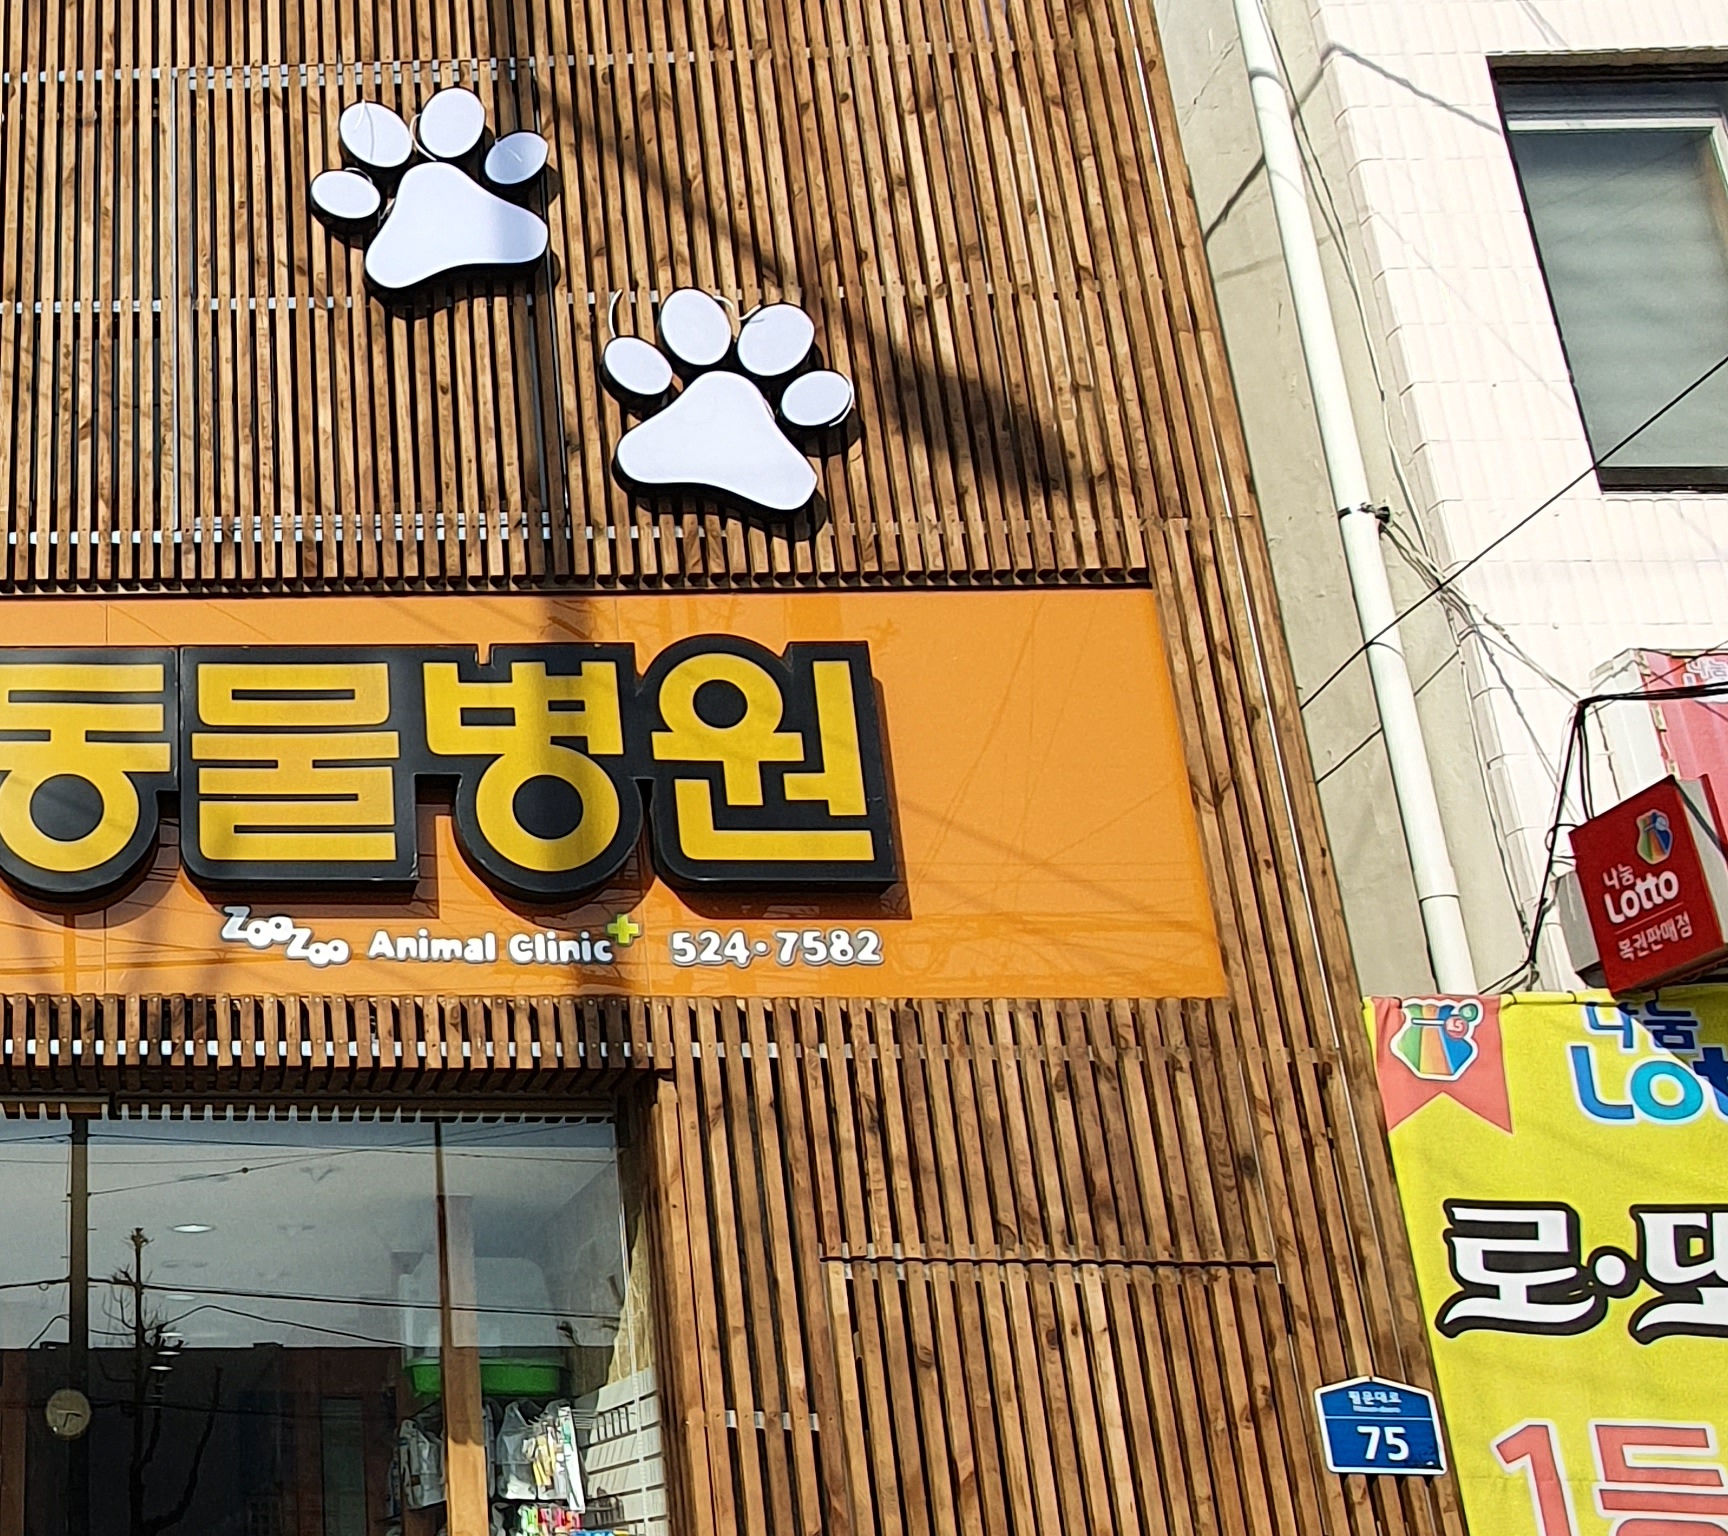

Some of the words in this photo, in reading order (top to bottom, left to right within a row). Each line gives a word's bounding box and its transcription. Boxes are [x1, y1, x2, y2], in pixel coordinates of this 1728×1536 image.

[1603, 863, 1636, 890] 나눔
[1603, 870, 1680, 924] Lotto
[221, 905, 350, 965] ZooZoo
[368, 928, 497, 963] Animal
[507, 930, 614, 964] Clinic
[1618, 911, 1693, 961] 복권판매점
[1357, 1426, 1409, 1461] 75
